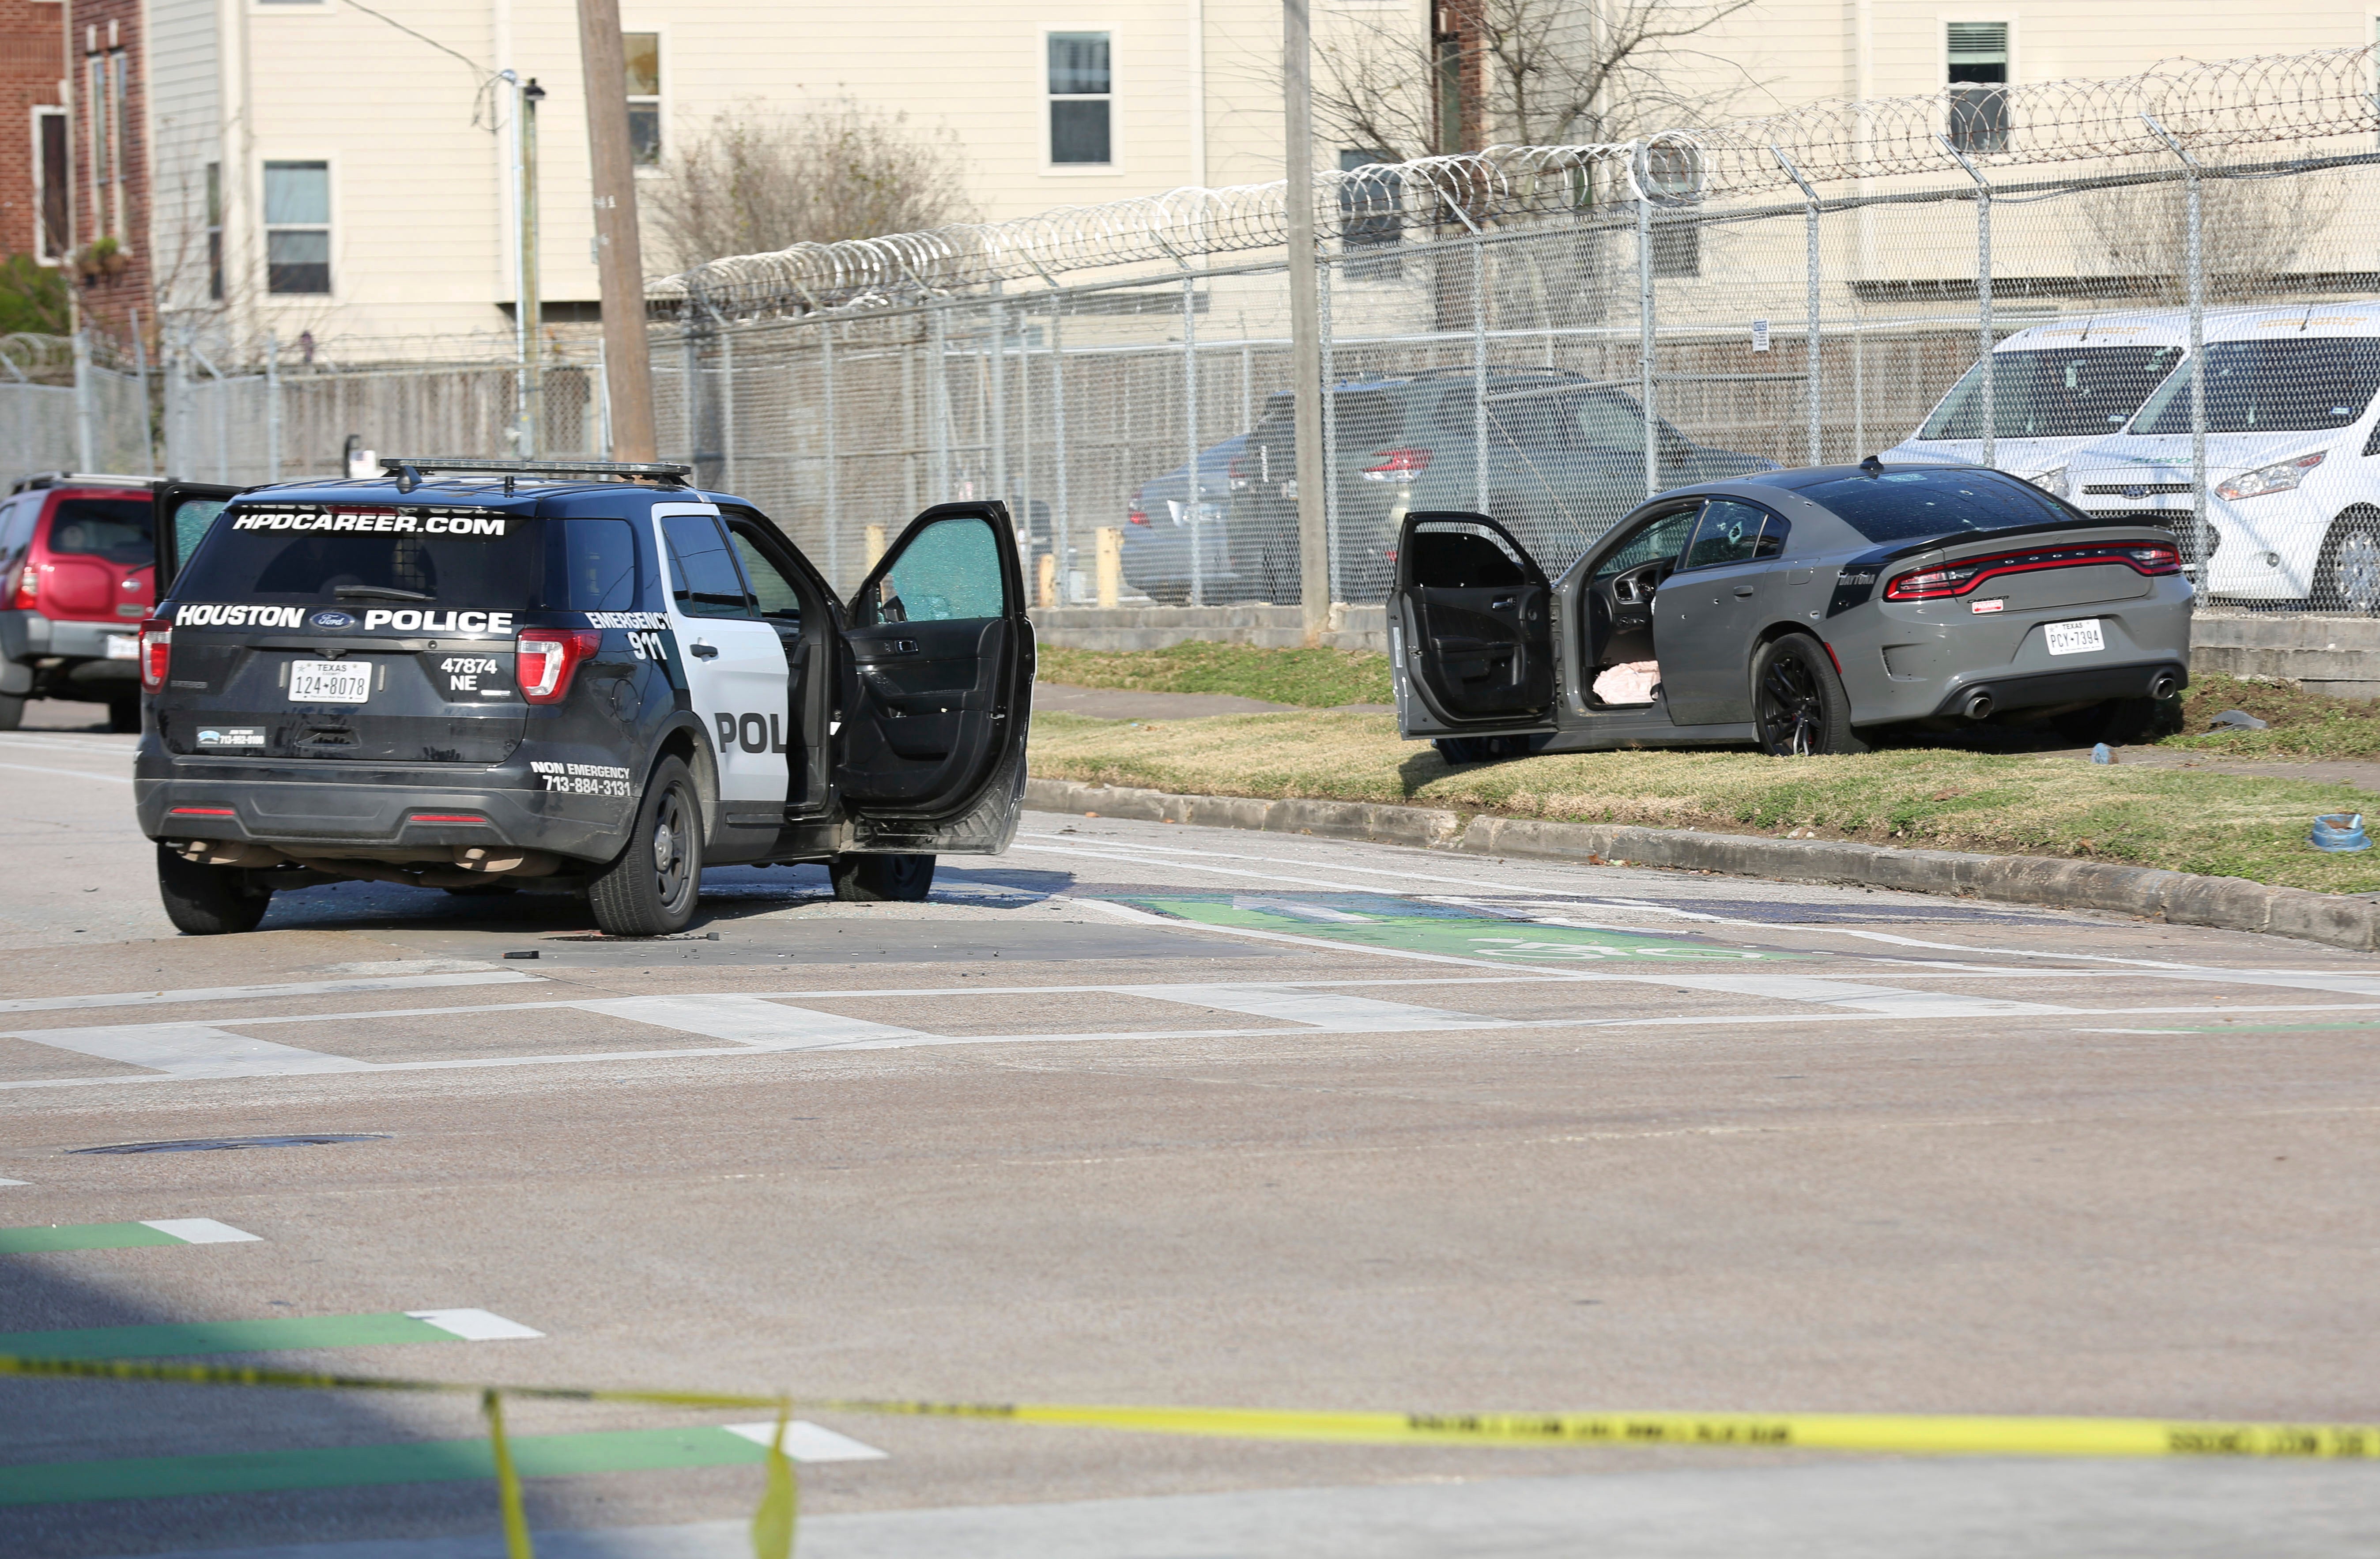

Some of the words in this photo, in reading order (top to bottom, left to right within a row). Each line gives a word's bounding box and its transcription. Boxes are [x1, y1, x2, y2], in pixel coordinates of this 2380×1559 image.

[232, 514, 505, 536] HPDCAREER.COM
[175, 605, 306, 628] HOUSTON
[364, 610, 513, 634] POLICE
[318, 614, 345, 625] Ford
[585, 612, 672, 630] EMERGENCY
[627, 631, 668, 660] 911
[441, 658, 498, 674] 47874
[450, 675, 477, 691] NE
[530, 761, 565, 774] NON
[566, 763, 630, 779] EMERGENCY
[542, 775, 630, 796] 713-884-3131
